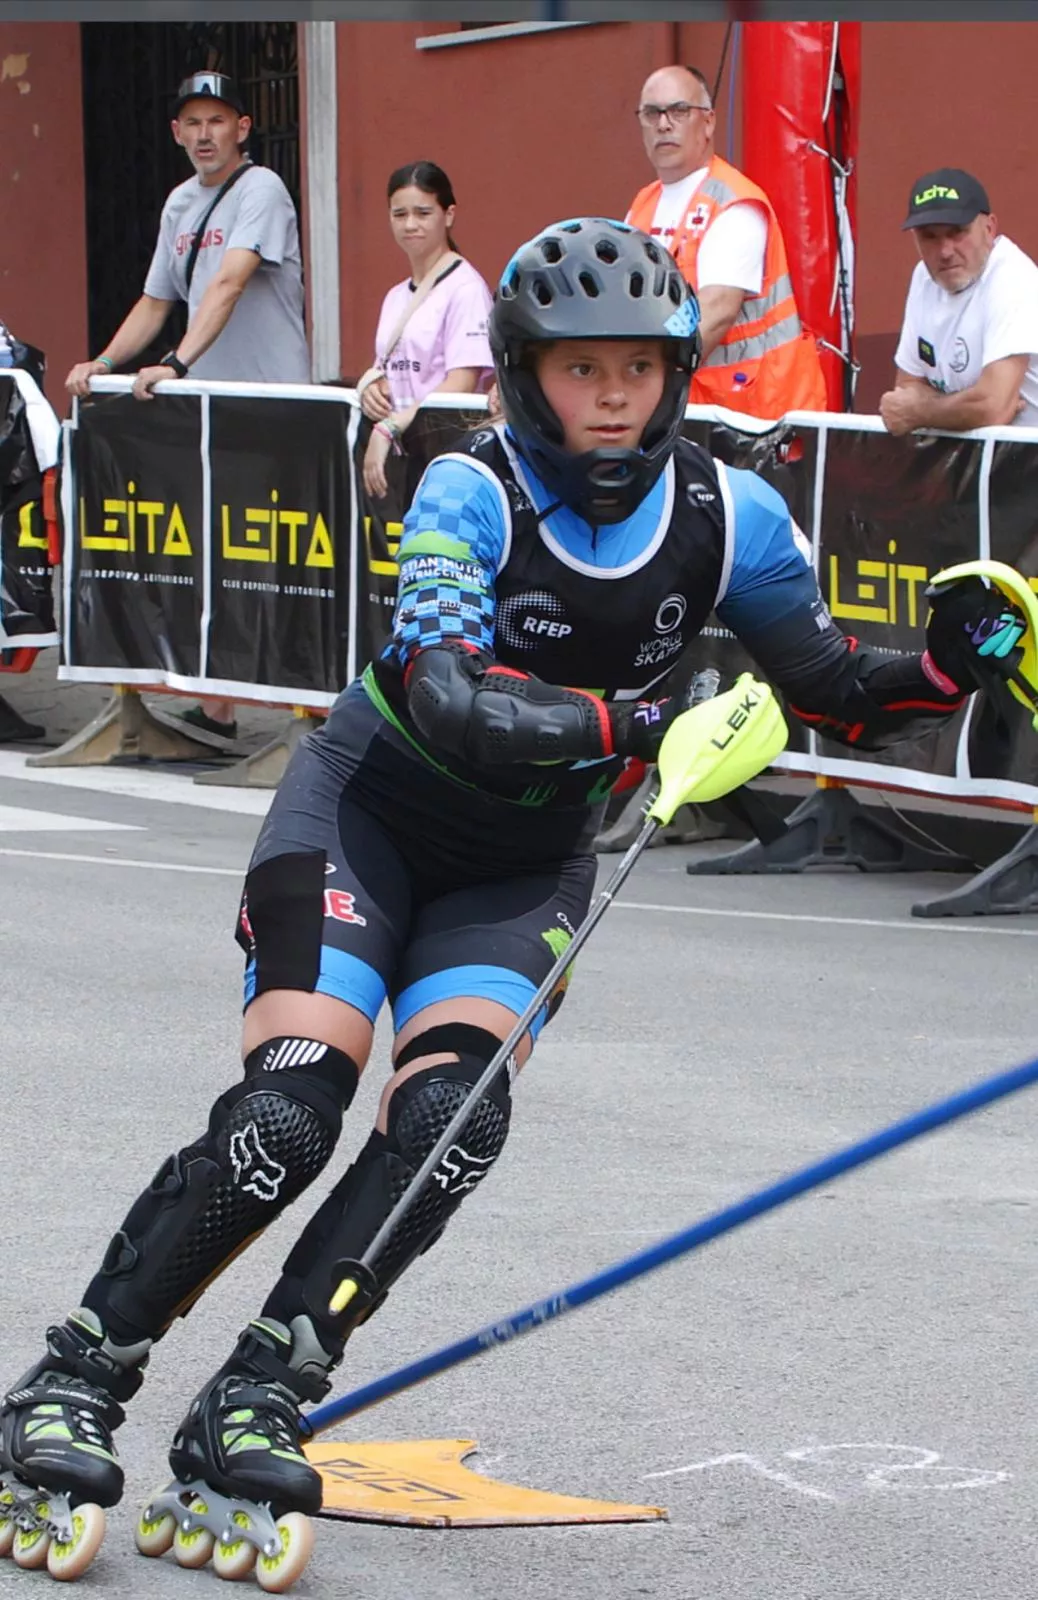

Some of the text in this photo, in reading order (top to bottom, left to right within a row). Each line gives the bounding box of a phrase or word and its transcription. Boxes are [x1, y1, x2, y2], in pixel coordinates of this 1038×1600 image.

[829, 539, 934, 629] LEIT
[523, 616, 573, 638] RFEP
[640, 632, 682, 653] WORLD
[711, 688, 762, 751] LEKI
